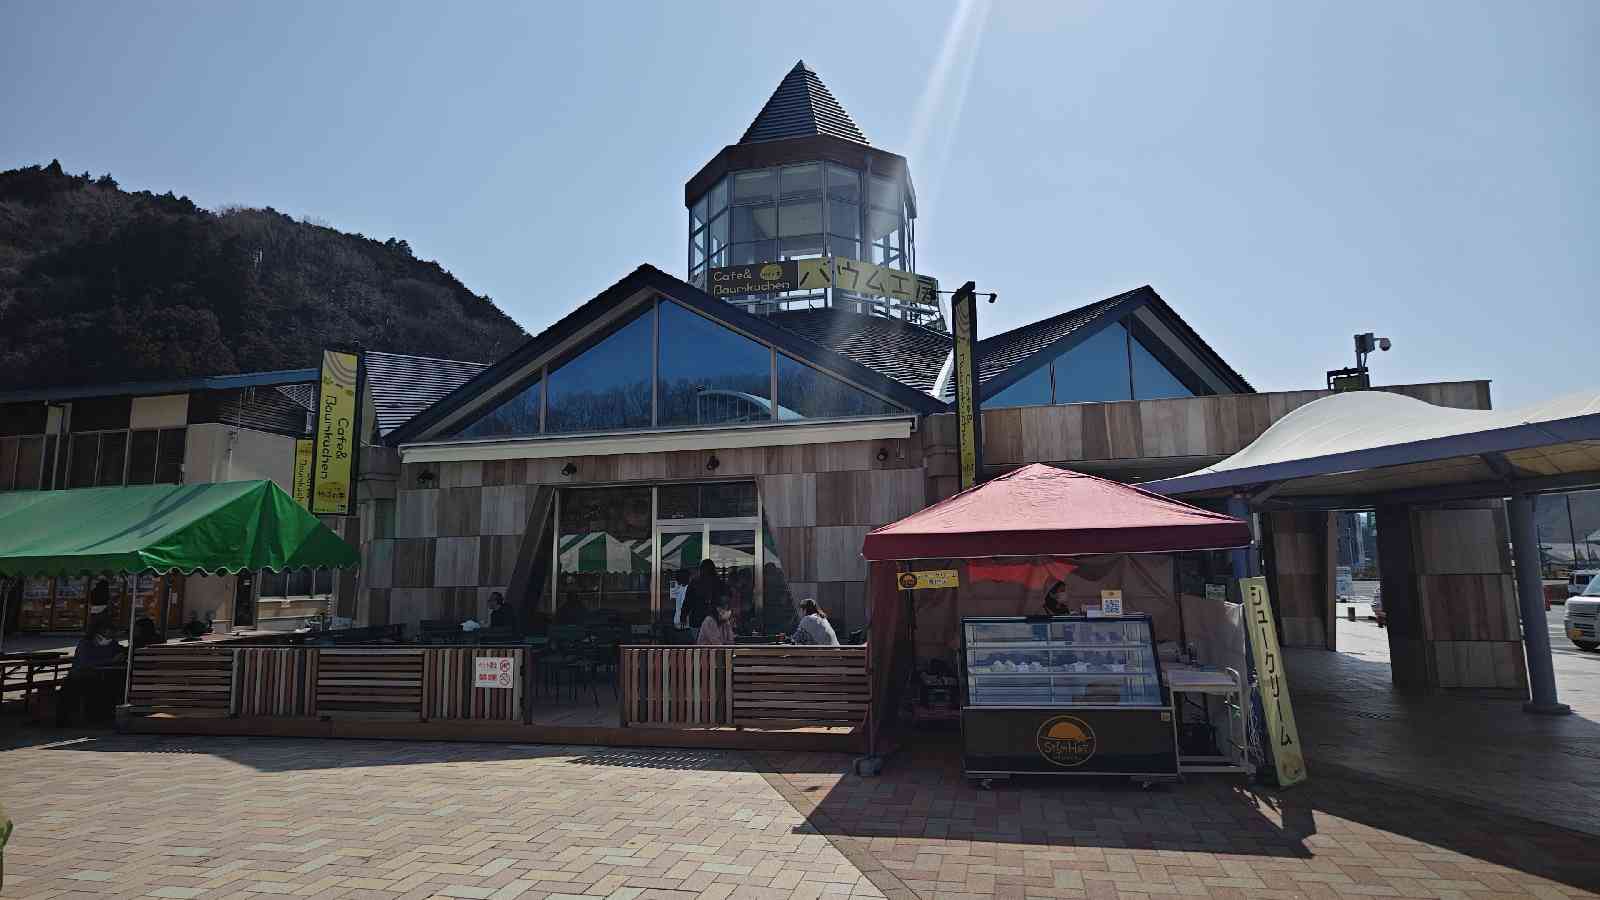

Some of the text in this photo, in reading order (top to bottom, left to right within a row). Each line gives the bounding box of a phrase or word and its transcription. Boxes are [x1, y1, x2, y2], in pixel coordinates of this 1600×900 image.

[713, 267, 752, 281] Cafe&
[336, 417, 349, 460] Cafe&
[1250, 586, 1292, 746] シュークリーム
